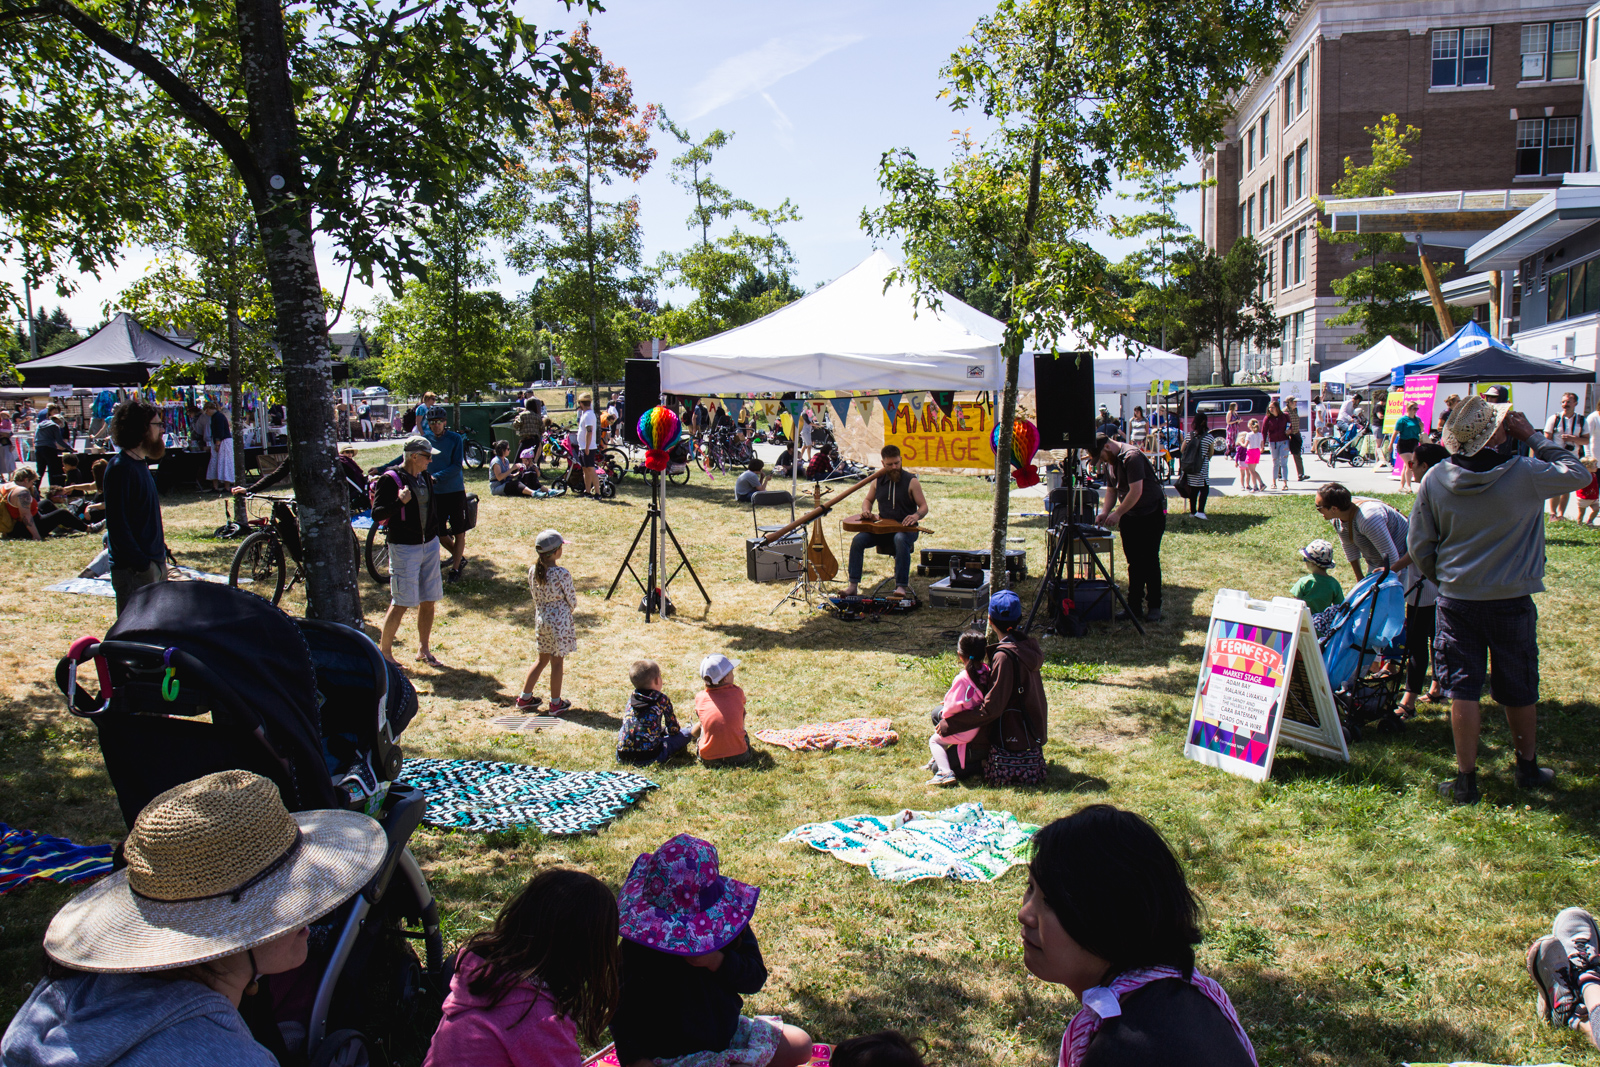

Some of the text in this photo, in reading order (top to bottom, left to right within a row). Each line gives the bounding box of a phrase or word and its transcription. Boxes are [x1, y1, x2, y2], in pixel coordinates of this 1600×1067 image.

[902, 436, 981, 462] STAGE
[1220, 640, 1277, 665] FERNFEST
[1222, 669, 1244, 680] MARKET
[1244, 674, 1263, 684] STAGE
[1226, 679, 1241, 687] ADAM
[1225, 687, 1246, 697] MALAIKA
[1246, 692, 1268, 702] LWAKILA
[1230, 702, 1248, 711] HILLBILLY
[1234, 709, 1258, 720] BATEMAN
[1219, 714, 1235, 723] TOADS
[1249, 722, 1262, 731] WIRE
